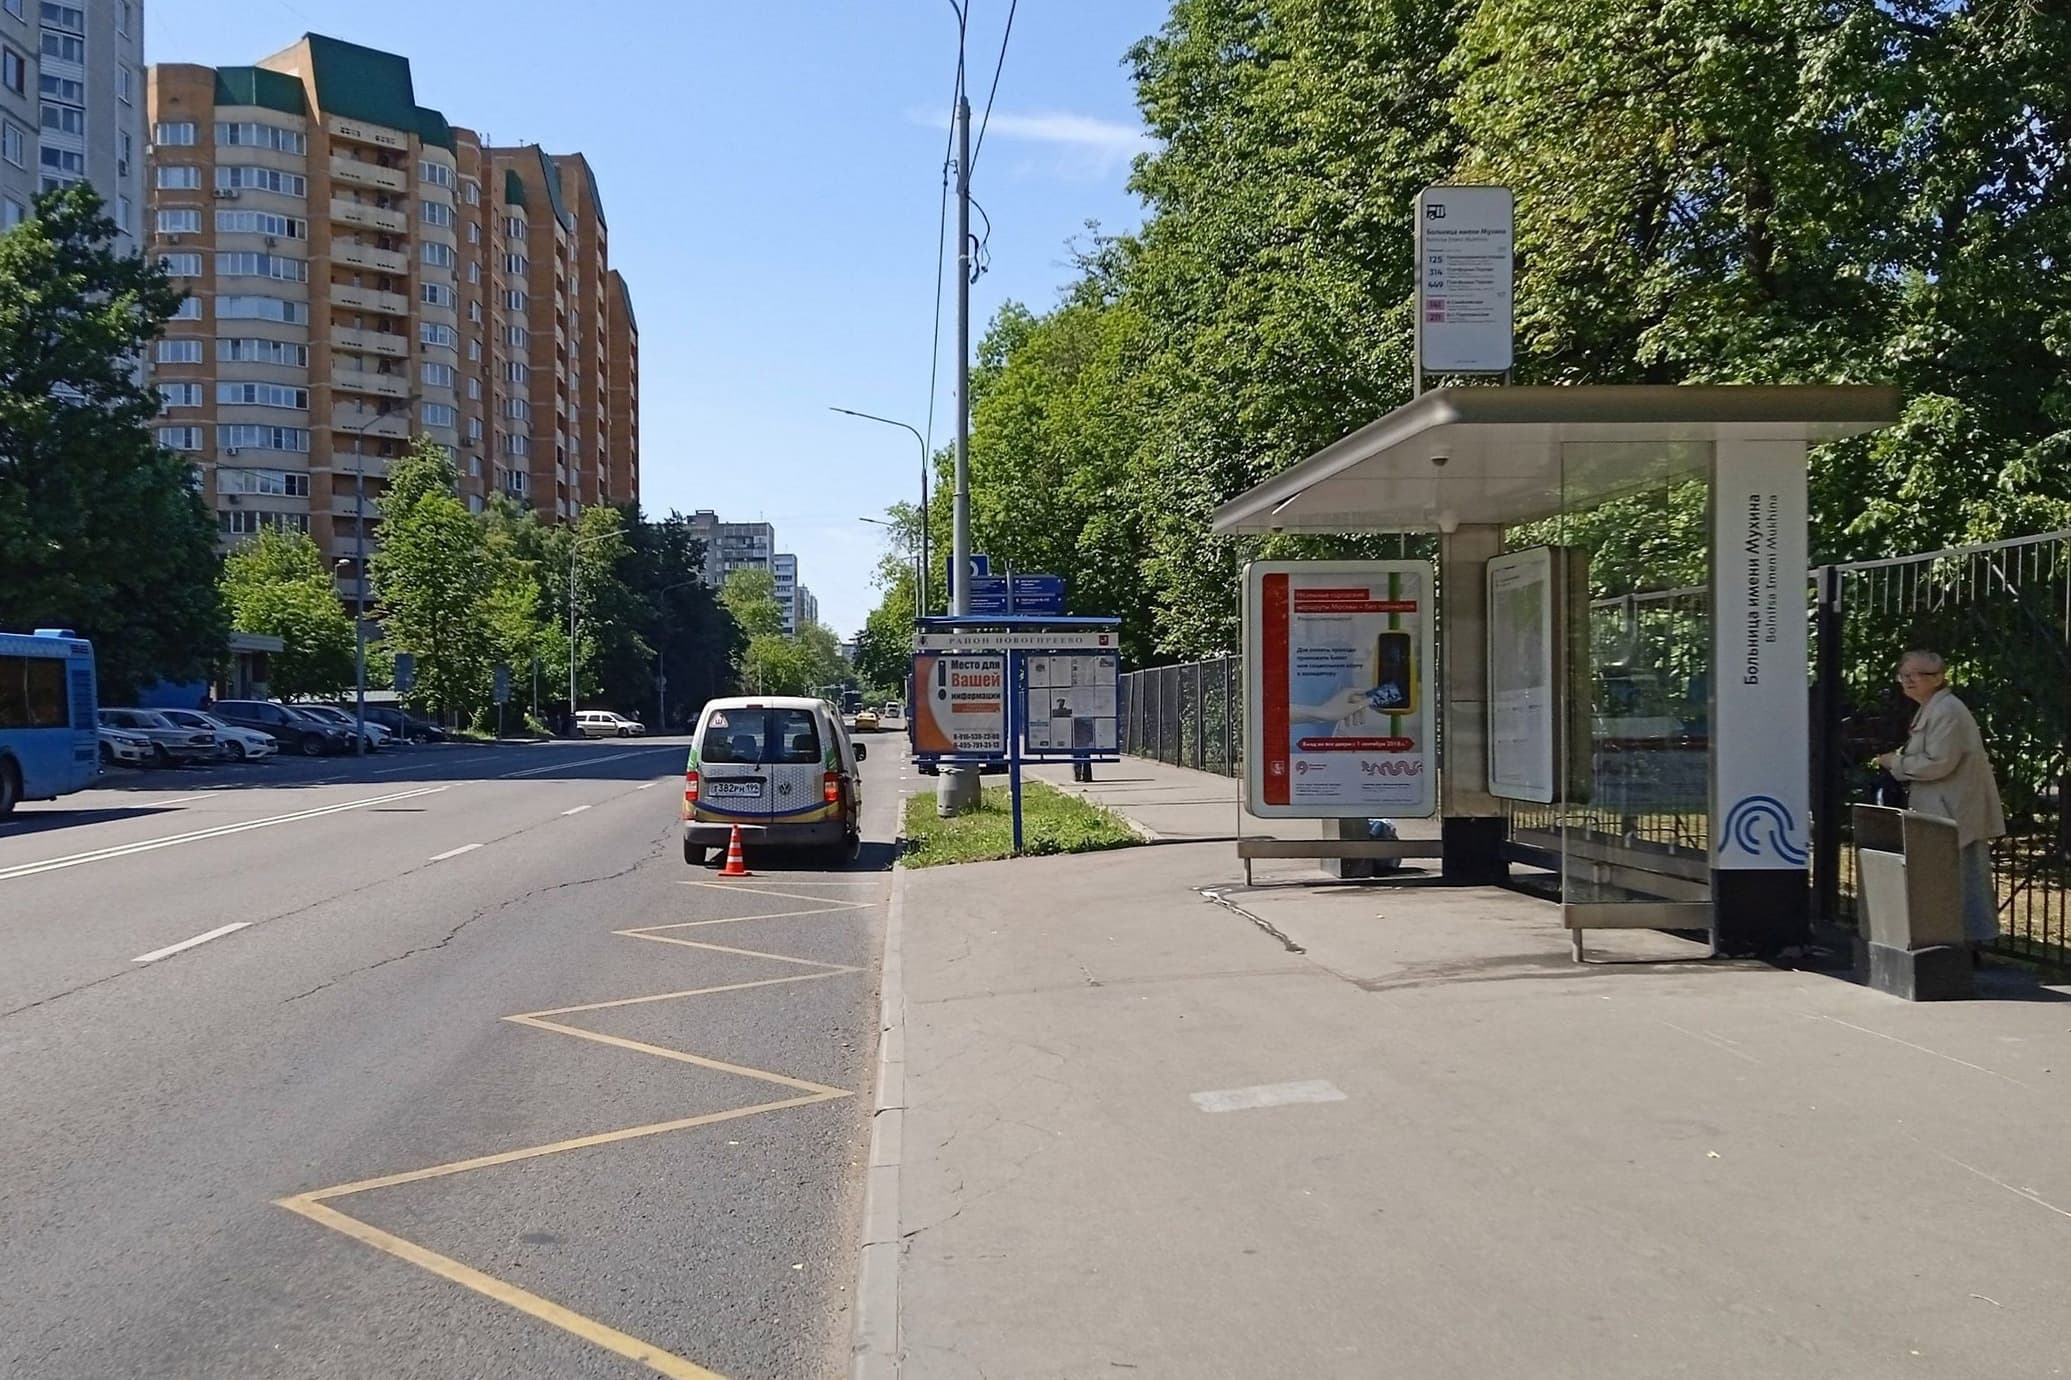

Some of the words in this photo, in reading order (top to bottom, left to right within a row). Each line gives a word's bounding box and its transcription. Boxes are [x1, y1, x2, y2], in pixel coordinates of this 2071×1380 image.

[1429, 255, 1443, 263] 125
[1745, 494, 1764, 554] Мухина
[1766, 495, 1778, 550] Mukhina
[1747, 558, 1761, 607] имени
[1765, 593, 1778, 643] Bolnitsa
[951, 660, 980, 670] Место
[981, 660, 1001, 671] для
[1744, 611, 1762, 685] Больница
[951, 671, 1001, 688] Вашей
[951, 691, 1001, 701] информации
